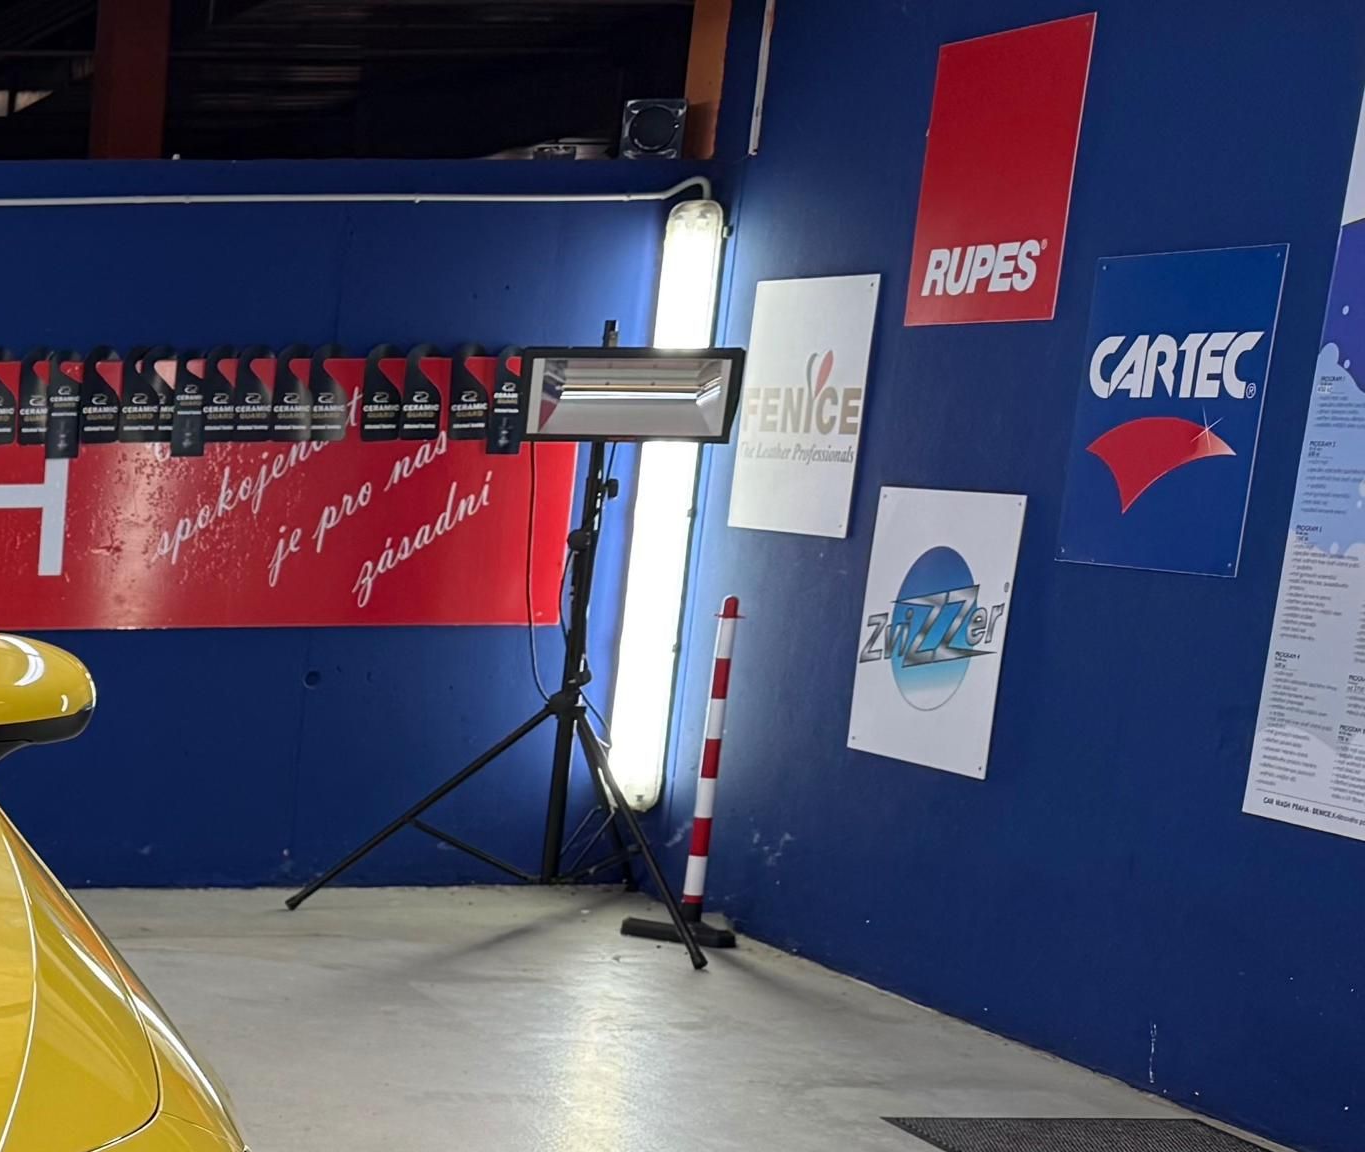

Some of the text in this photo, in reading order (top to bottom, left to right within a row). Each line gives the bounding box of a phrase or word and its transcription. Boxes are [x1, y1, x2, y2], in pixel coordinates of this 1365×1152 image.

[921, 240, 1039, 297] RUPES
[1088, 331, 1266, 399] CARTEC
[50, 395, 80, 403] CERAMIC
[82, 406, 118, 414] CERAMIC
[122, 405, 158, 414] CERAMIC
[235, 405, 271, 413] CERAMIC
[273, 405, 310, 413] CERAMIC
[363, 404, 400, 412] CERAMIC
[403, 403, 439, 411] CERAMIC
[451, 403, 487, 411] CERAMIC
[744, 385, 863, 435] FENICE
[791, 443, 854, 465] Professionals
[151, 386, 363, 565] spokojent
[268, 525, 302, 587] je
[312, 481, 373, 553] pro
[352, 470, 493, 608] zásadní
